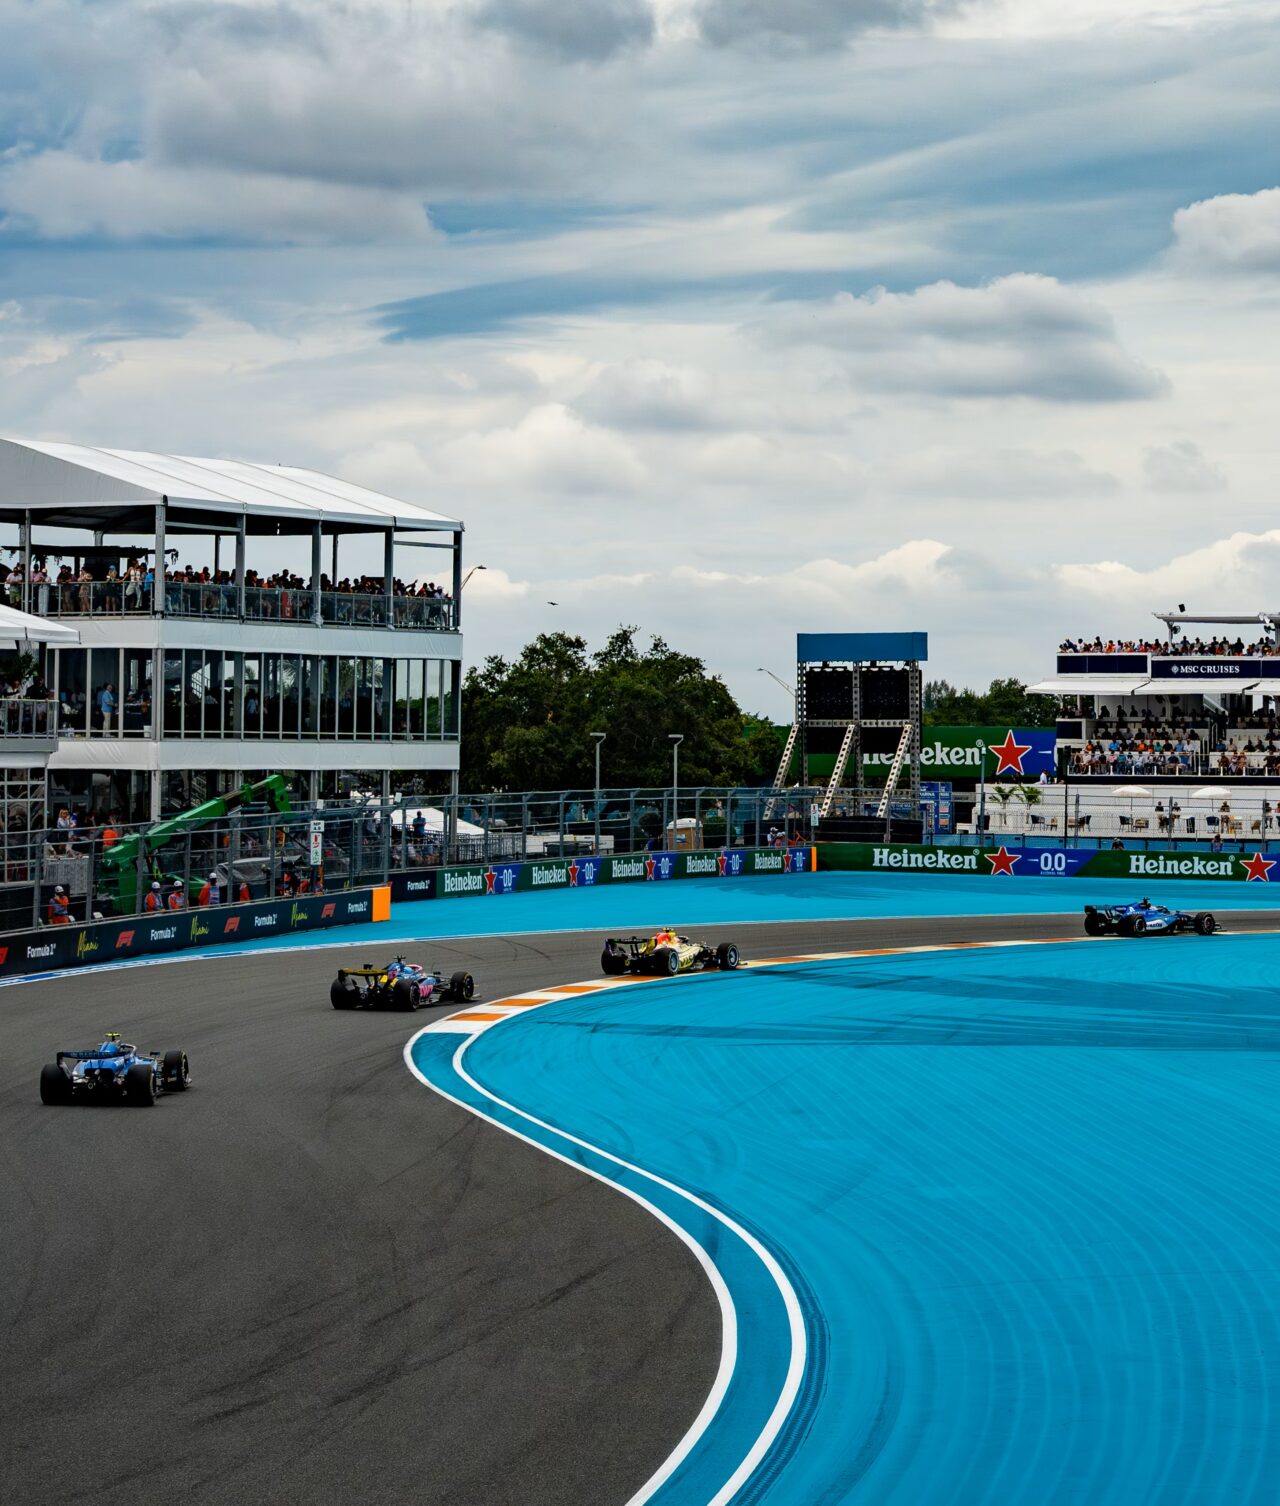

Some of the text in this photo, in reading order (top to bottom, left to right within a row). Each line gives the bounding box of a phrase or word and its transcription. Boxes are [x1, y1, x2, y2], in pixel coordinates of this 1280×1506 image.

[1180, 665, 1240, 674] MSC CRUISES
[1040, 852, 1066, 871] 0.0
[407, 880, 426, 890] Formula
[150, 928, 170, 941] Formula
[27, 944, 49, 958] Formula
